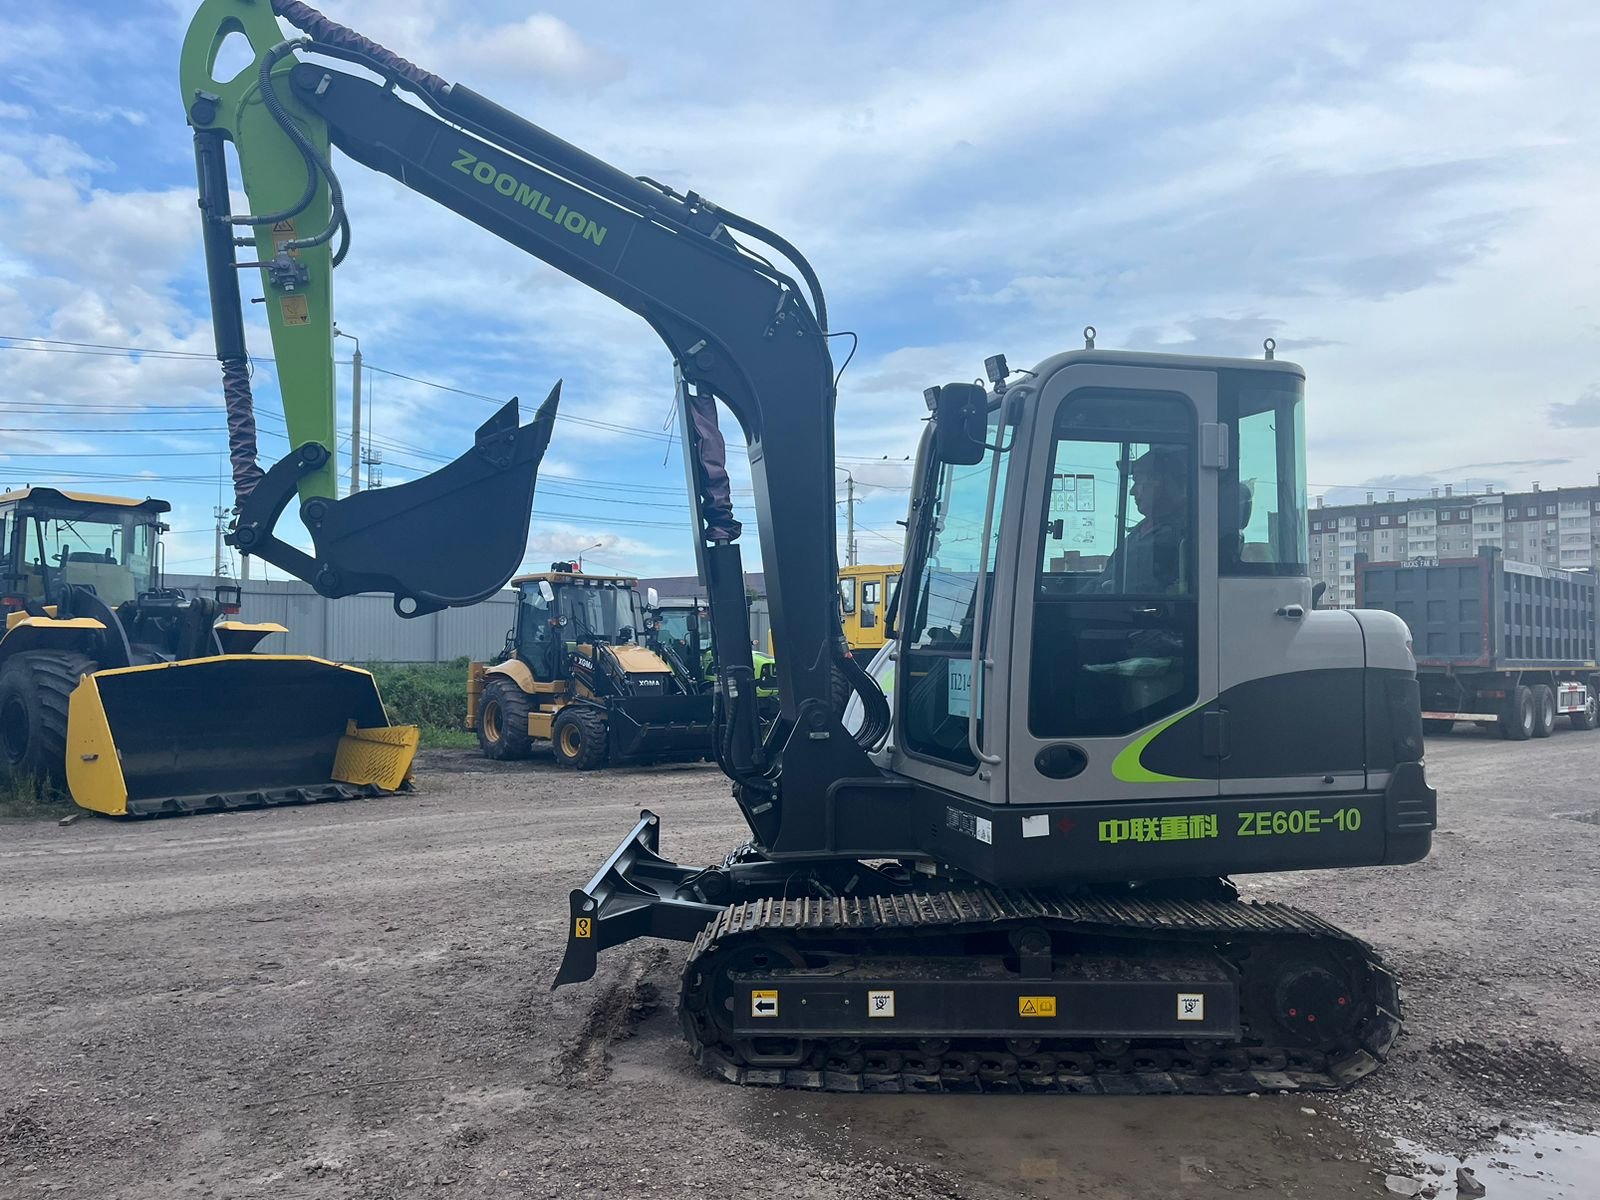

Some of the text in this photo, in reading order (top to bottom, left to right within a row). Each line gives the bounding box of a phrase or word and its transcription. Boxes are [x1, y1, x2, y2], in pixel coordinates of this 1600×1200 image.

[451, 148, 607, 246] ZOOMLION
[1098, 807, 1361, 844] 中联重科 ZE60E-10
